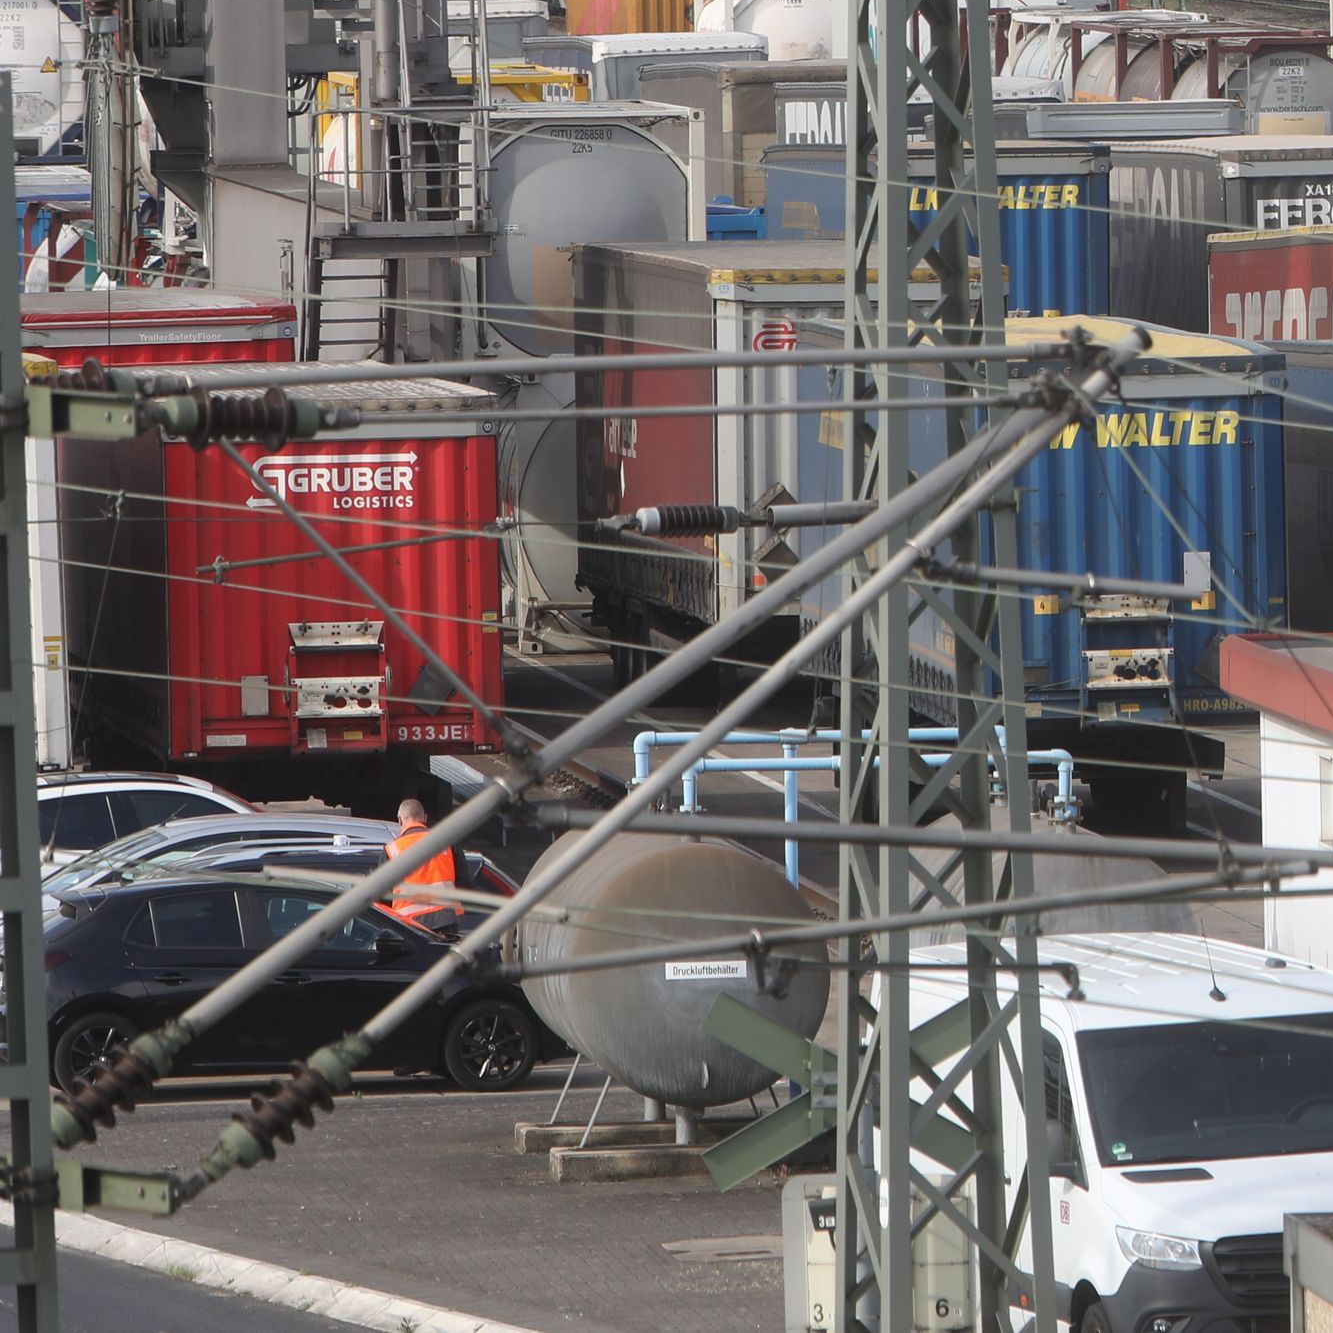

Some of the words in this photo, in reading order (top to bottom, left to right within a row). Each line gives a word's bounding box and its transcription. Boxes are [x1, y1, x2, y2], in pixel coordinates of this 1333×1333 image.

[550, 129, 572, 139] GITU
[997, 184, 1079, 210] ALTER
[1095, 410, 1240, 449] WALTER
[288, 467, 414, 493] GRUBER
[333, 495, 414, 509] LOGISTICS
[672, 964, 739, 977] Druckluftbehälter
[813, 1303, 824, 1322] 3
[935, 1298, 949, 1318] 6
